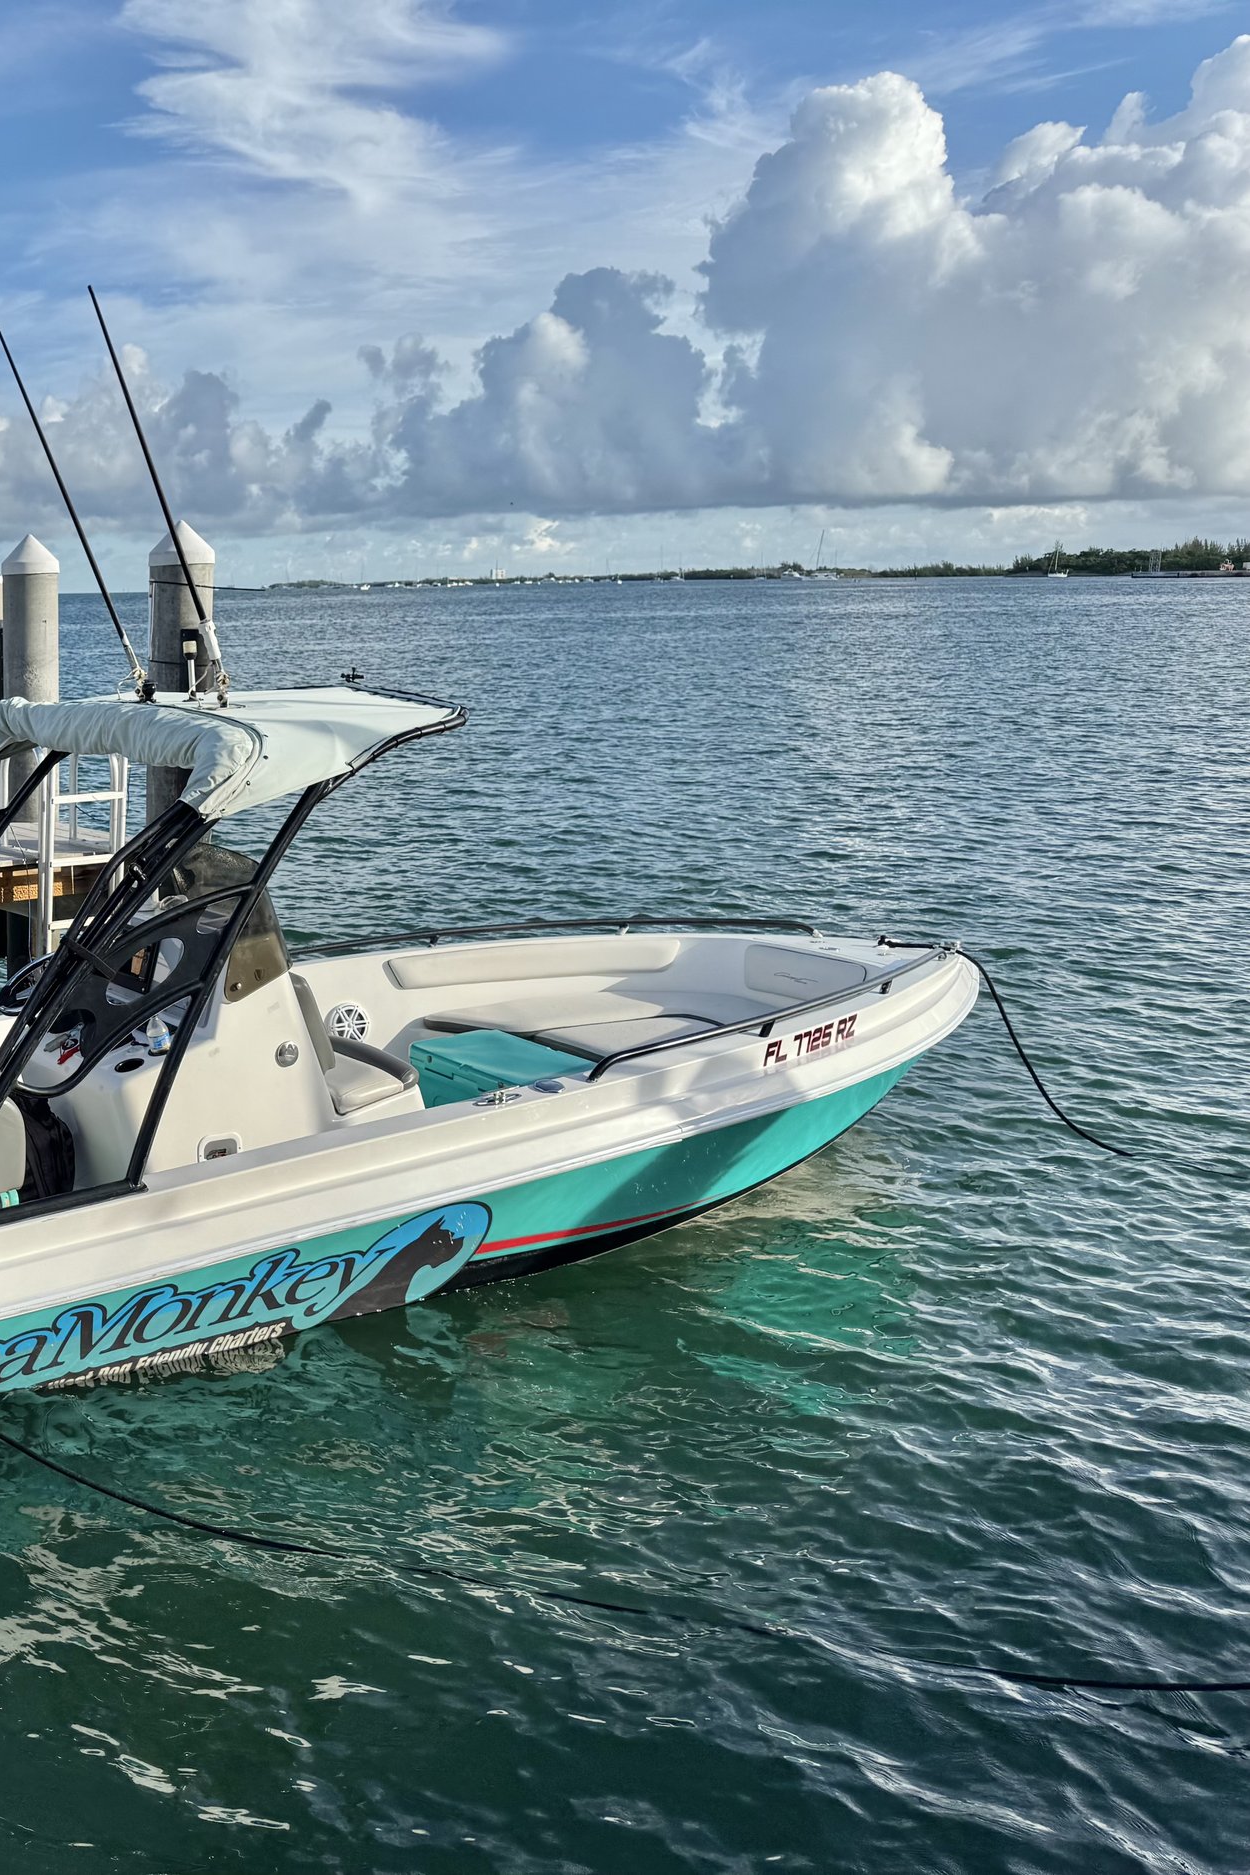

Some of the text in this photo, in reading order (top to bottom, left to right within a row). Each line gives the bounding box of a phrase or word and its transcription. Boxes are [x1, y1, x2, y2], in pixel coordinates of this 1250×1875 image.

[763, 1014, 858, 1067] FL 7725 RZ
[135, 1341, 209, 1371] Friendly
[209, 1321, 287, 1354] Charters
